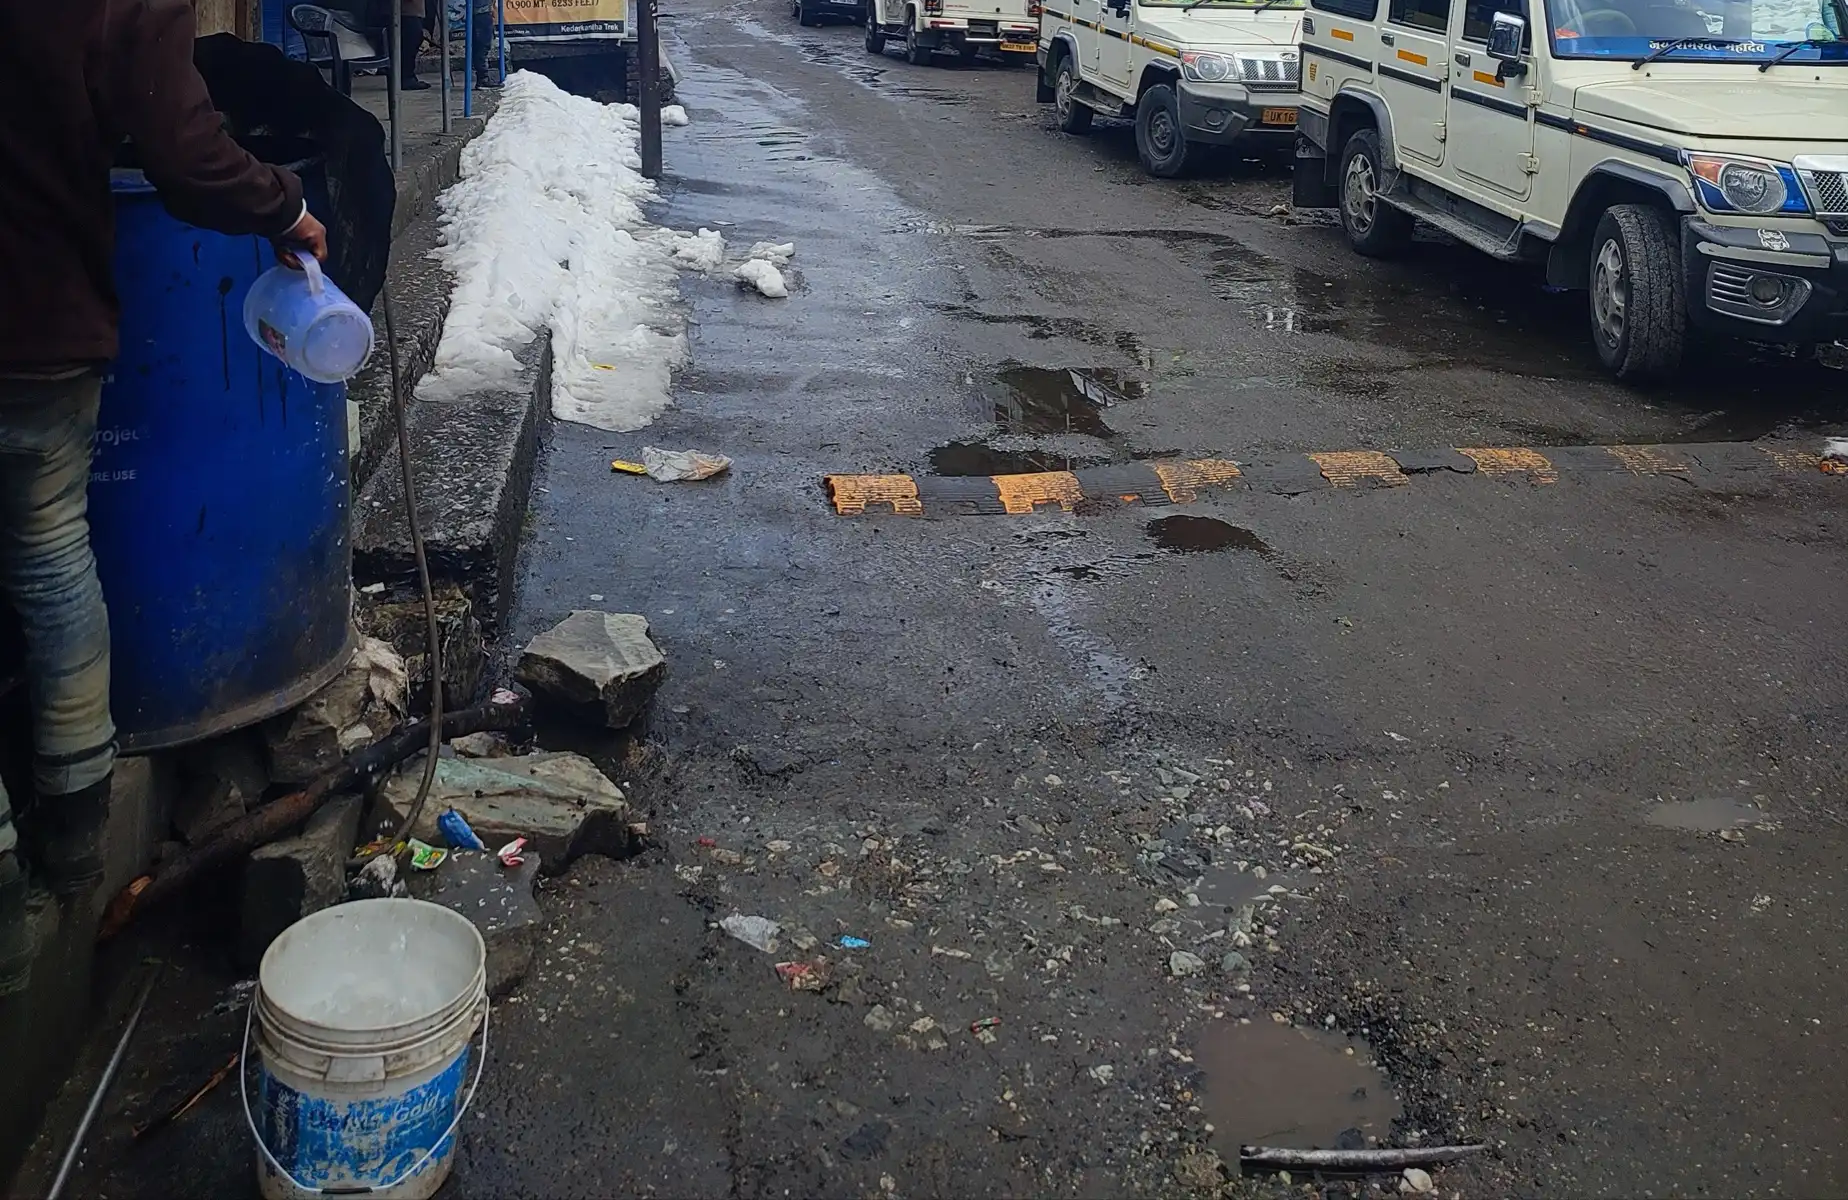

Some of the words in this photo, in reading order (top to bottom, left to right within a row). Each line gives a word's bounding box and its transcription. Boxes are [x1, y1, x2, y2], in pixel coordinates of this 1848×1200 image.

[505, 0, 532, 10] (1900
[560, 24, 603, 33] Kedarkantha
[603, 22, 619, 31] Trek
[112, 469, 138, 481] USE
